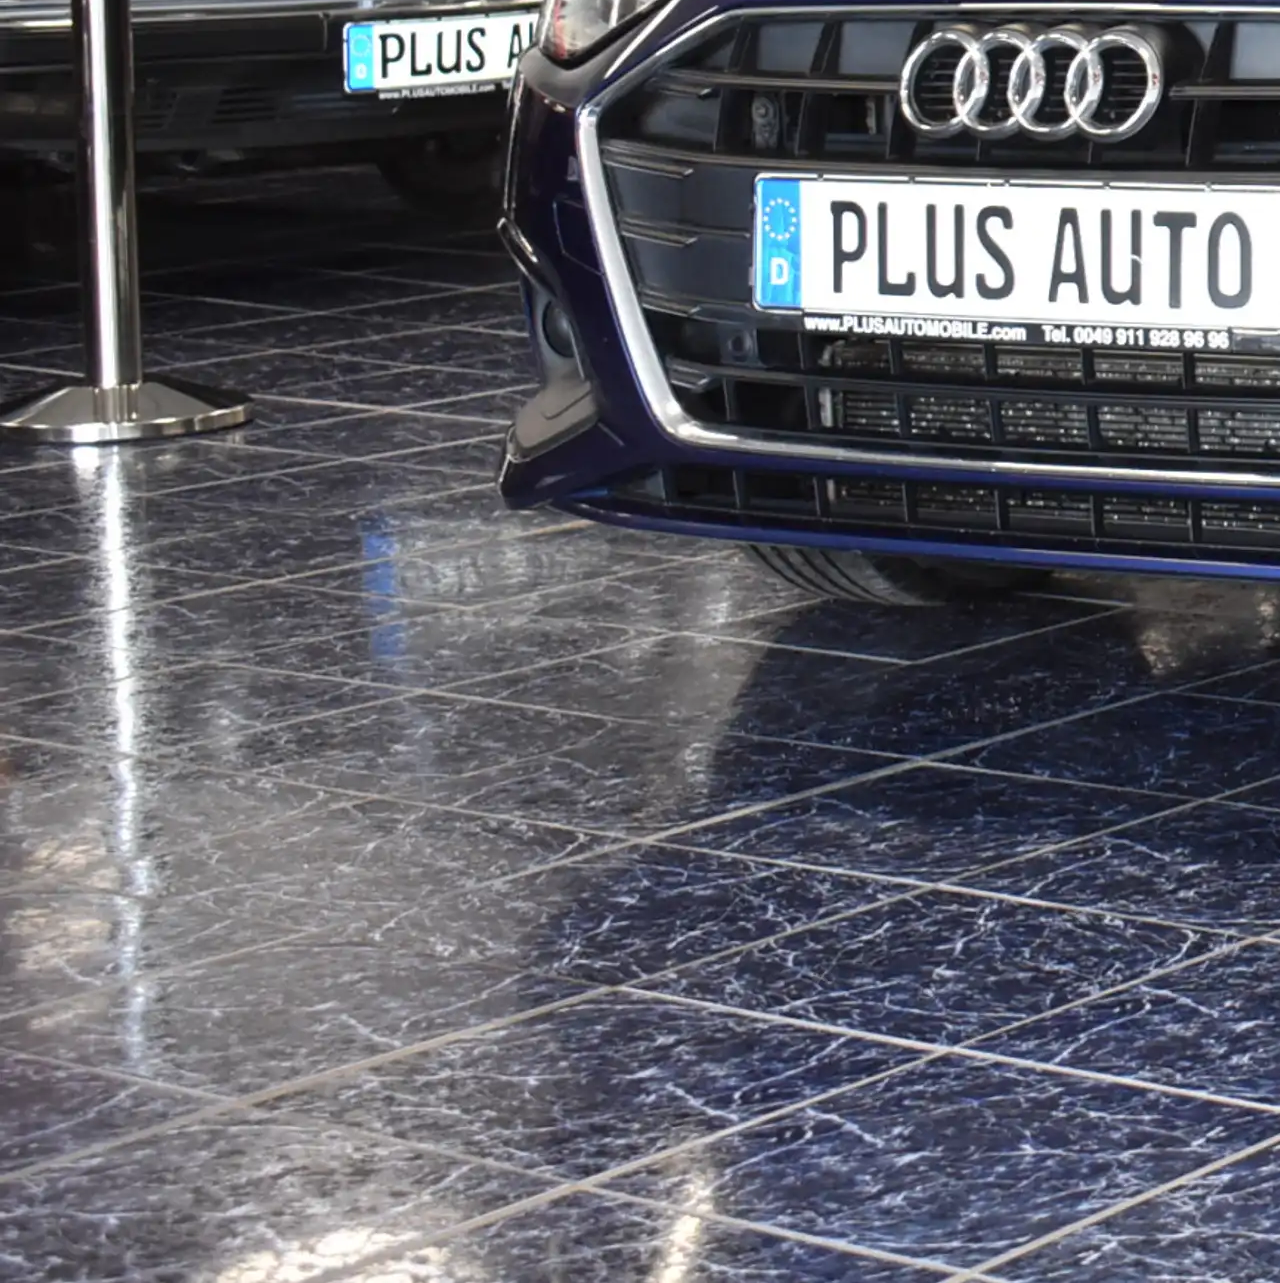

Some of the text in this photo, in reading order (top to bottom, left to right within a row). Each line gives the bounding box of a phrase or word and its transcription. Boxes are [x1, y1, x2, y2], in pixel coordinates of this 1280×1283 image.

[379, 26, 487, 79] PLUS
[770, 257, 789, 285] D
[830, 200, 1254, 309] PLUS AUTO
[803, 315, 1230, 349] www.PLUSAUTOMOBILE.com Tel. 0049 911 928 96 96
